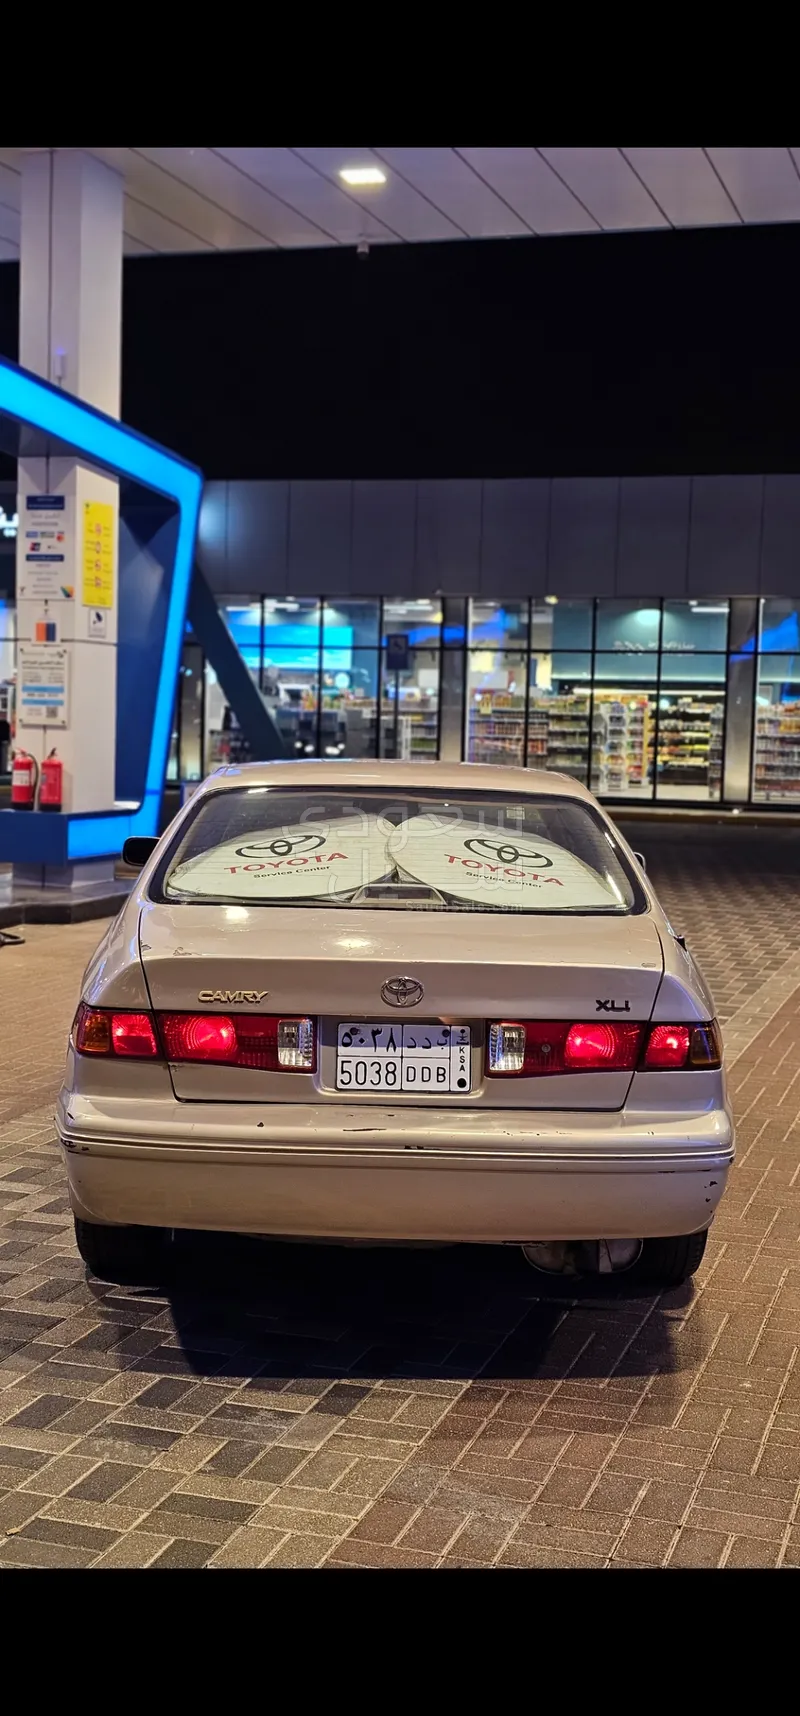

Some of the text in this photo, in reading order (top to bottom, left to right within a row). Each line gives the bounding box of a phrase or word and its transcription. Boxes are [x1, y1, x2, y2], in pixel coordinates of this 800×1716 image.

[224, 852, 348, 874] TOYOTA
[253, 865, 331, 879] Service Center
[444, 853, 565, 887] TOYOTA
[465, 871, 543, 888] Service Center
[198, 990, 269, 1003] CAMRY
[341, 1027, 397, 1052] ٥٠٣٨
[340, 1060, 397, 1086] 5038
